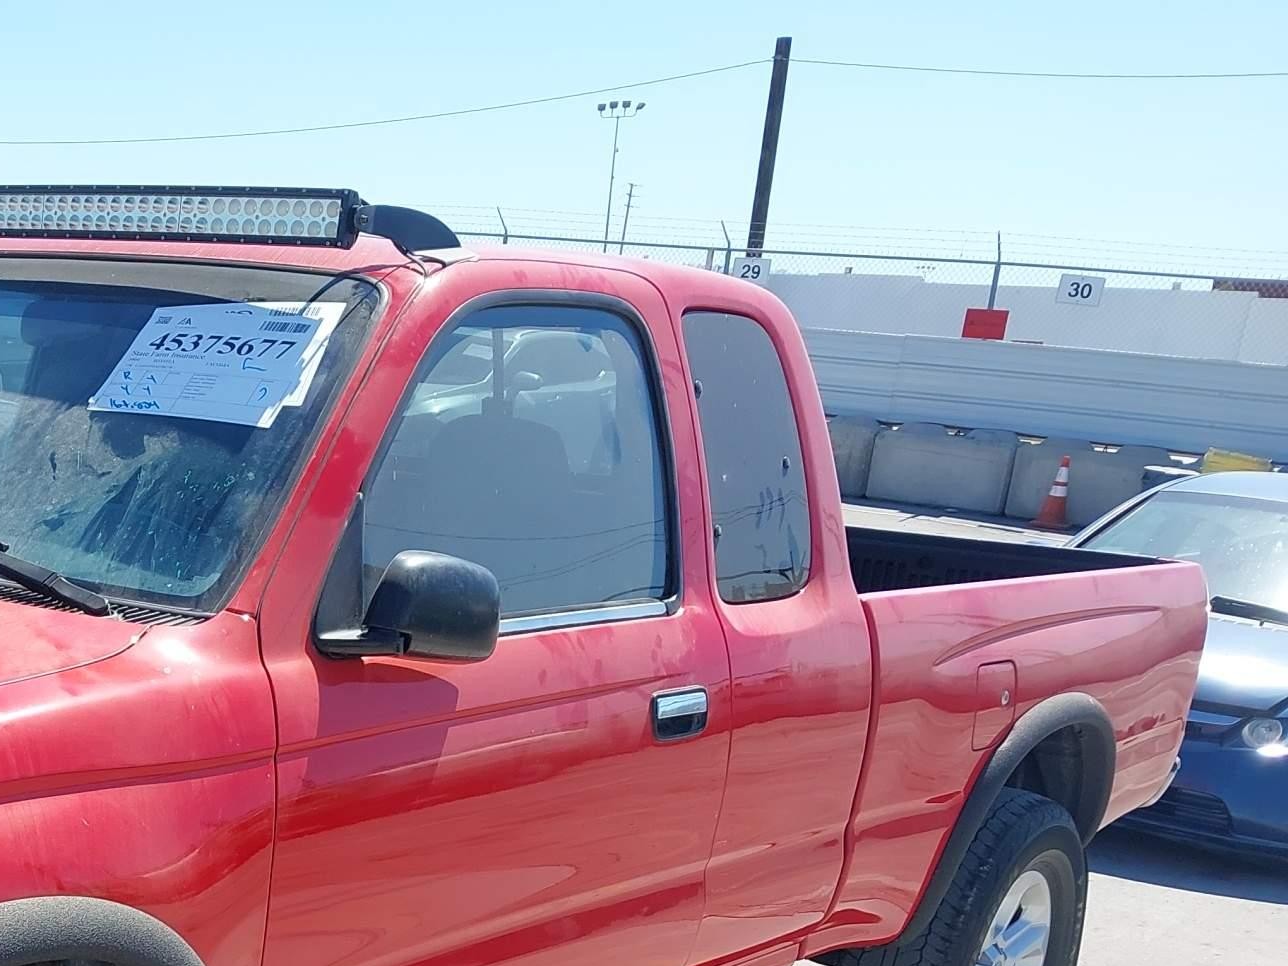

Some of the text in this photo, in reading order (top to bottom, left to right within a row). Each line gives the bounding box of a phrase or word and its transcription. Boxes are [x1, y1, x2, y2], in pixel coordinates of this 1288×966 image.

[741, 264, 761, 279] 29
[1067, 282, 1093, 299] 30
[149, 332, 297, 359] 45375677
[131, 350, 151, 358] State
[150, 350, 170, 359] Farm
[169, 351, 208, 361] Insurance
